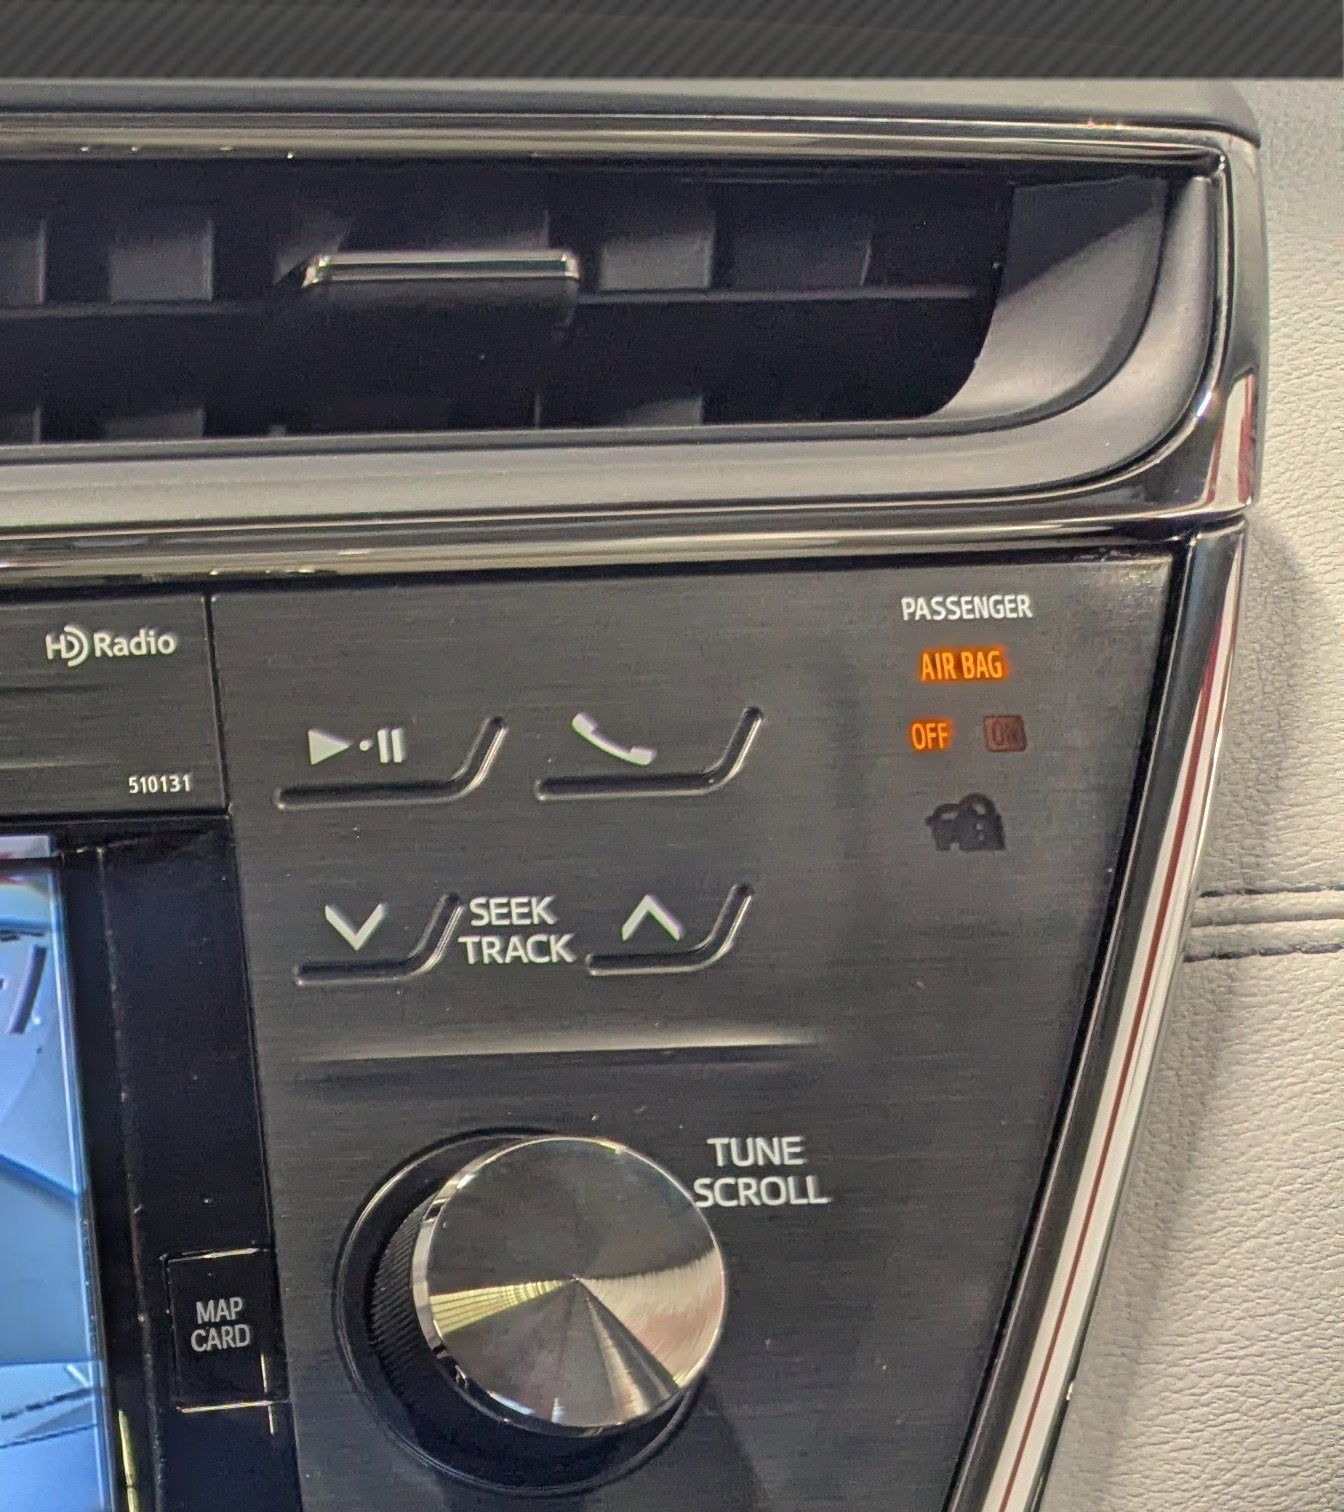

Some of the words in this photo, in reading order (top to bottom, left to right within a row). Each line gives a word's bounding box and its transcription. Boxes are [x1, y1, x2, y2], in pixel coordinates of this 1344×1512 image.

[900, 594, 1034, 621] PASSENGER
[93, 627, 178, 658] Radio
[920, 651, 957, 681] AIR
[960, 649, 1004, 680] BAG
[911, 722, 950, 751] OFF
[127, 773, 195, 795] 510131
[469, 895, 558, 926] SEEK
[458, 932, 578, 965] TRACK
[706, 1136, 809, 1167] TUNE
[693, 1175, 836, 1208] SCROLL
[195, 1296, 244, 1324] MAP
[190, 1324, 252, 1352] CARD
